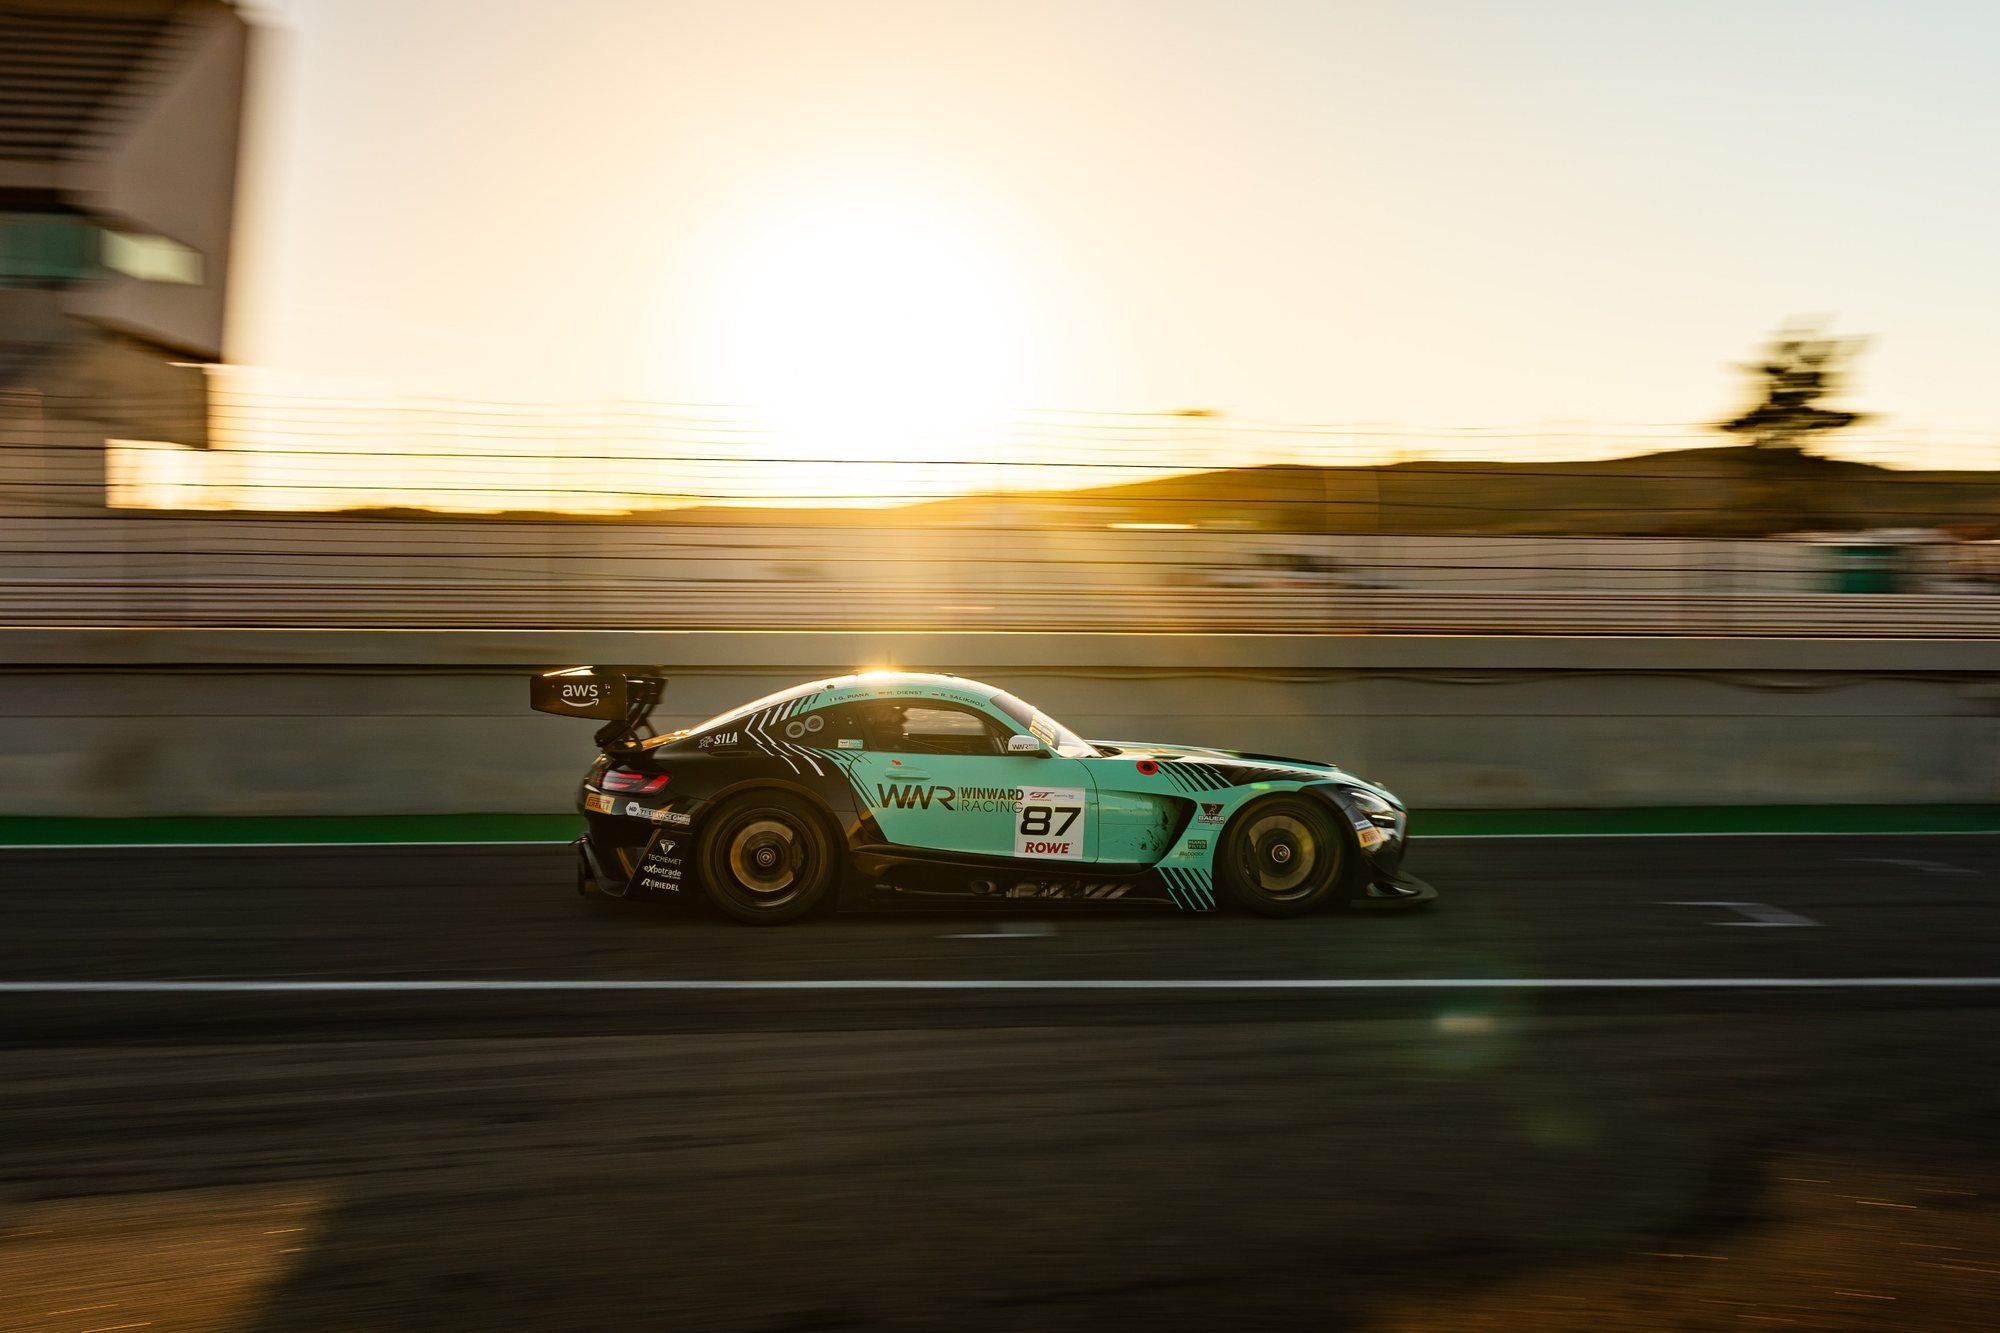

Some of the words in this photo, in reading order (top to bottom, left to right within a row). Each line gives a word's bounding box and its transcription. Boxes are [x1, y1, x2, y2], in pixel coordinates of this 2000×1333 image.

[562, 684, 599, 697] aws
[714, 731, 738, 745] SILA
[960, 787, 1024, 801] WINWARD
[961, 800, 1024, 813] RACING
[1020, 806, 1082, 837] 87
[1024, 841, 1071, 854] ROWE
[648, 854, 682, 865] TECHEMET
[654, 881, 680, 892] RIEDEL
